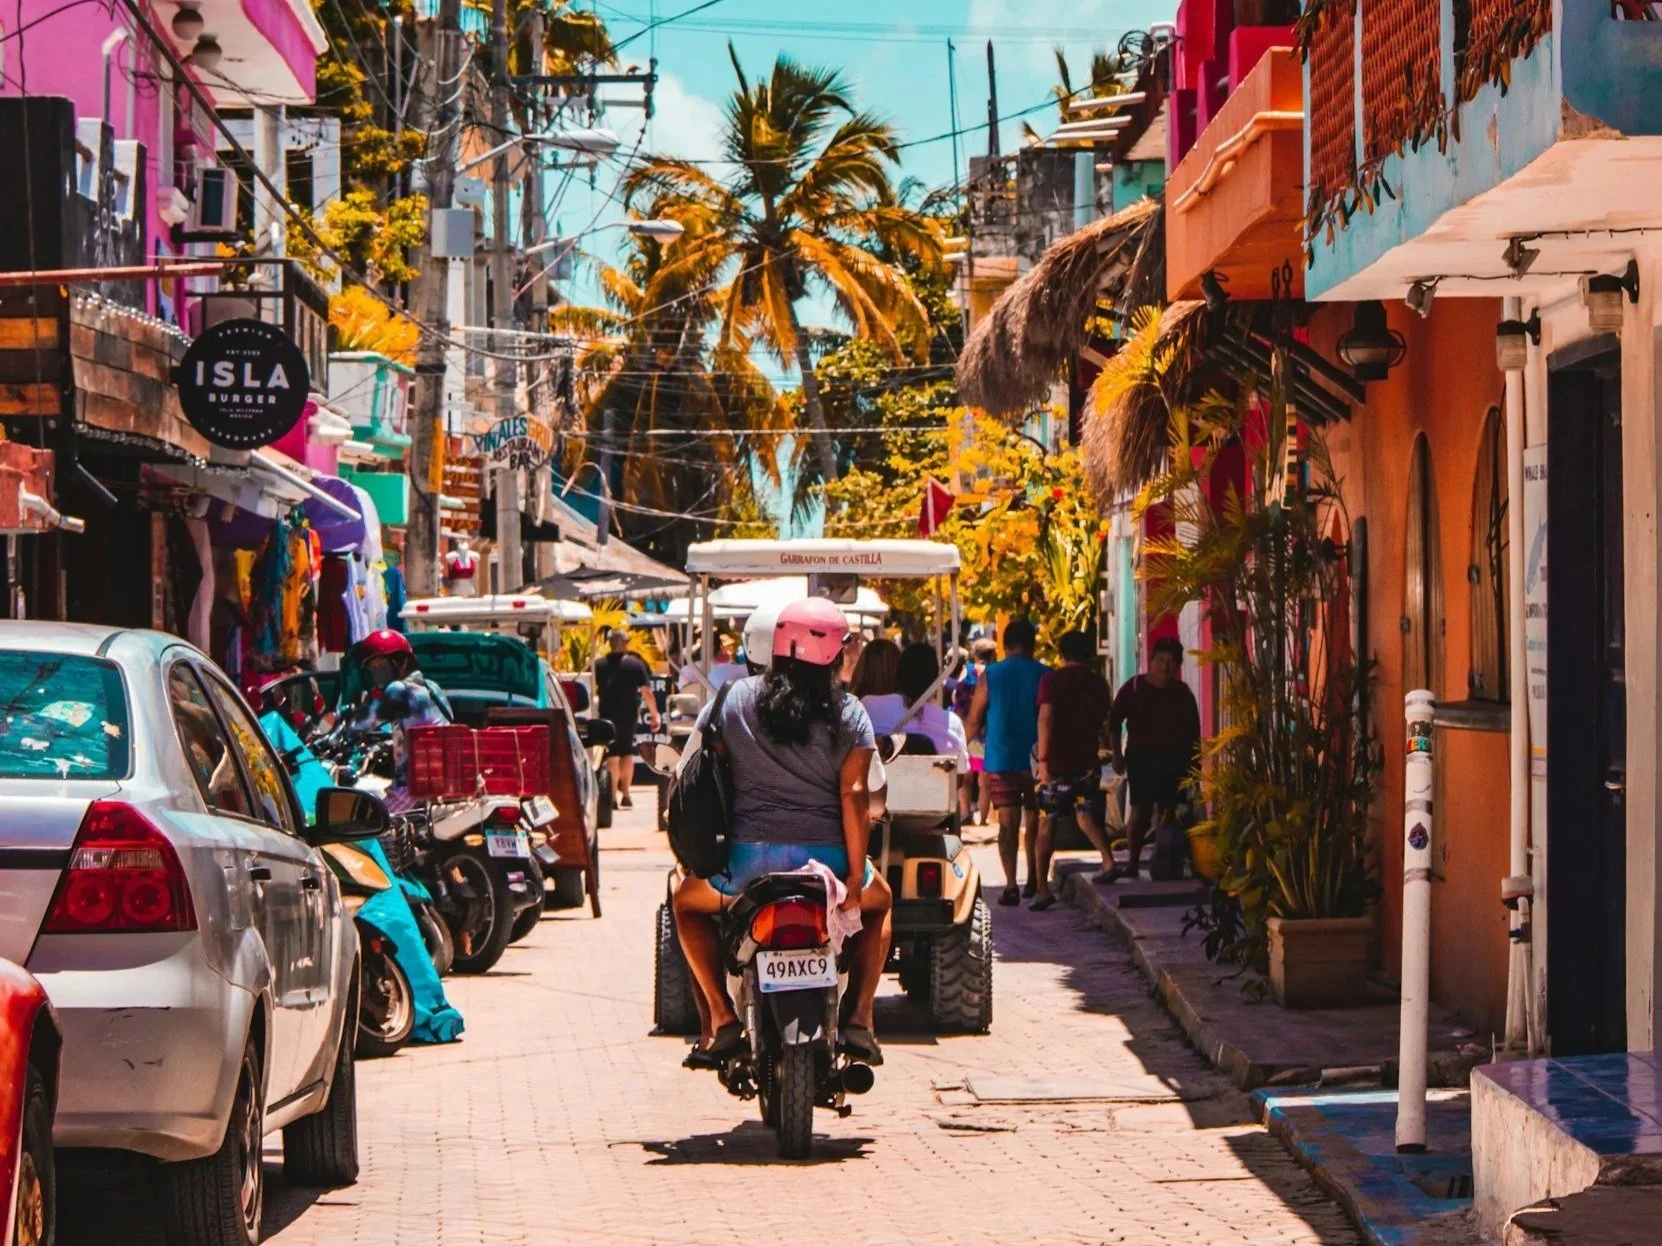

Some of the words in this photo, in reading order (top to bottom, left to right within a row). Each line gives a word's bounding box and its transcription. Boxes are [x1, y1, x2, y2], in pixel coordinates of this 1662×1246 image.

[196, 361, 290, 389] ISLA
[208, 392, 276, 404] BURGER
[509, 452, 531, 471] BAR
[780, 552, 826, 565] GARRAFON
[829, 556, 840, 565] DE
[842, 552, 882, 565] CASTILLA
[766, 958, 827, 979] 49AXC9
